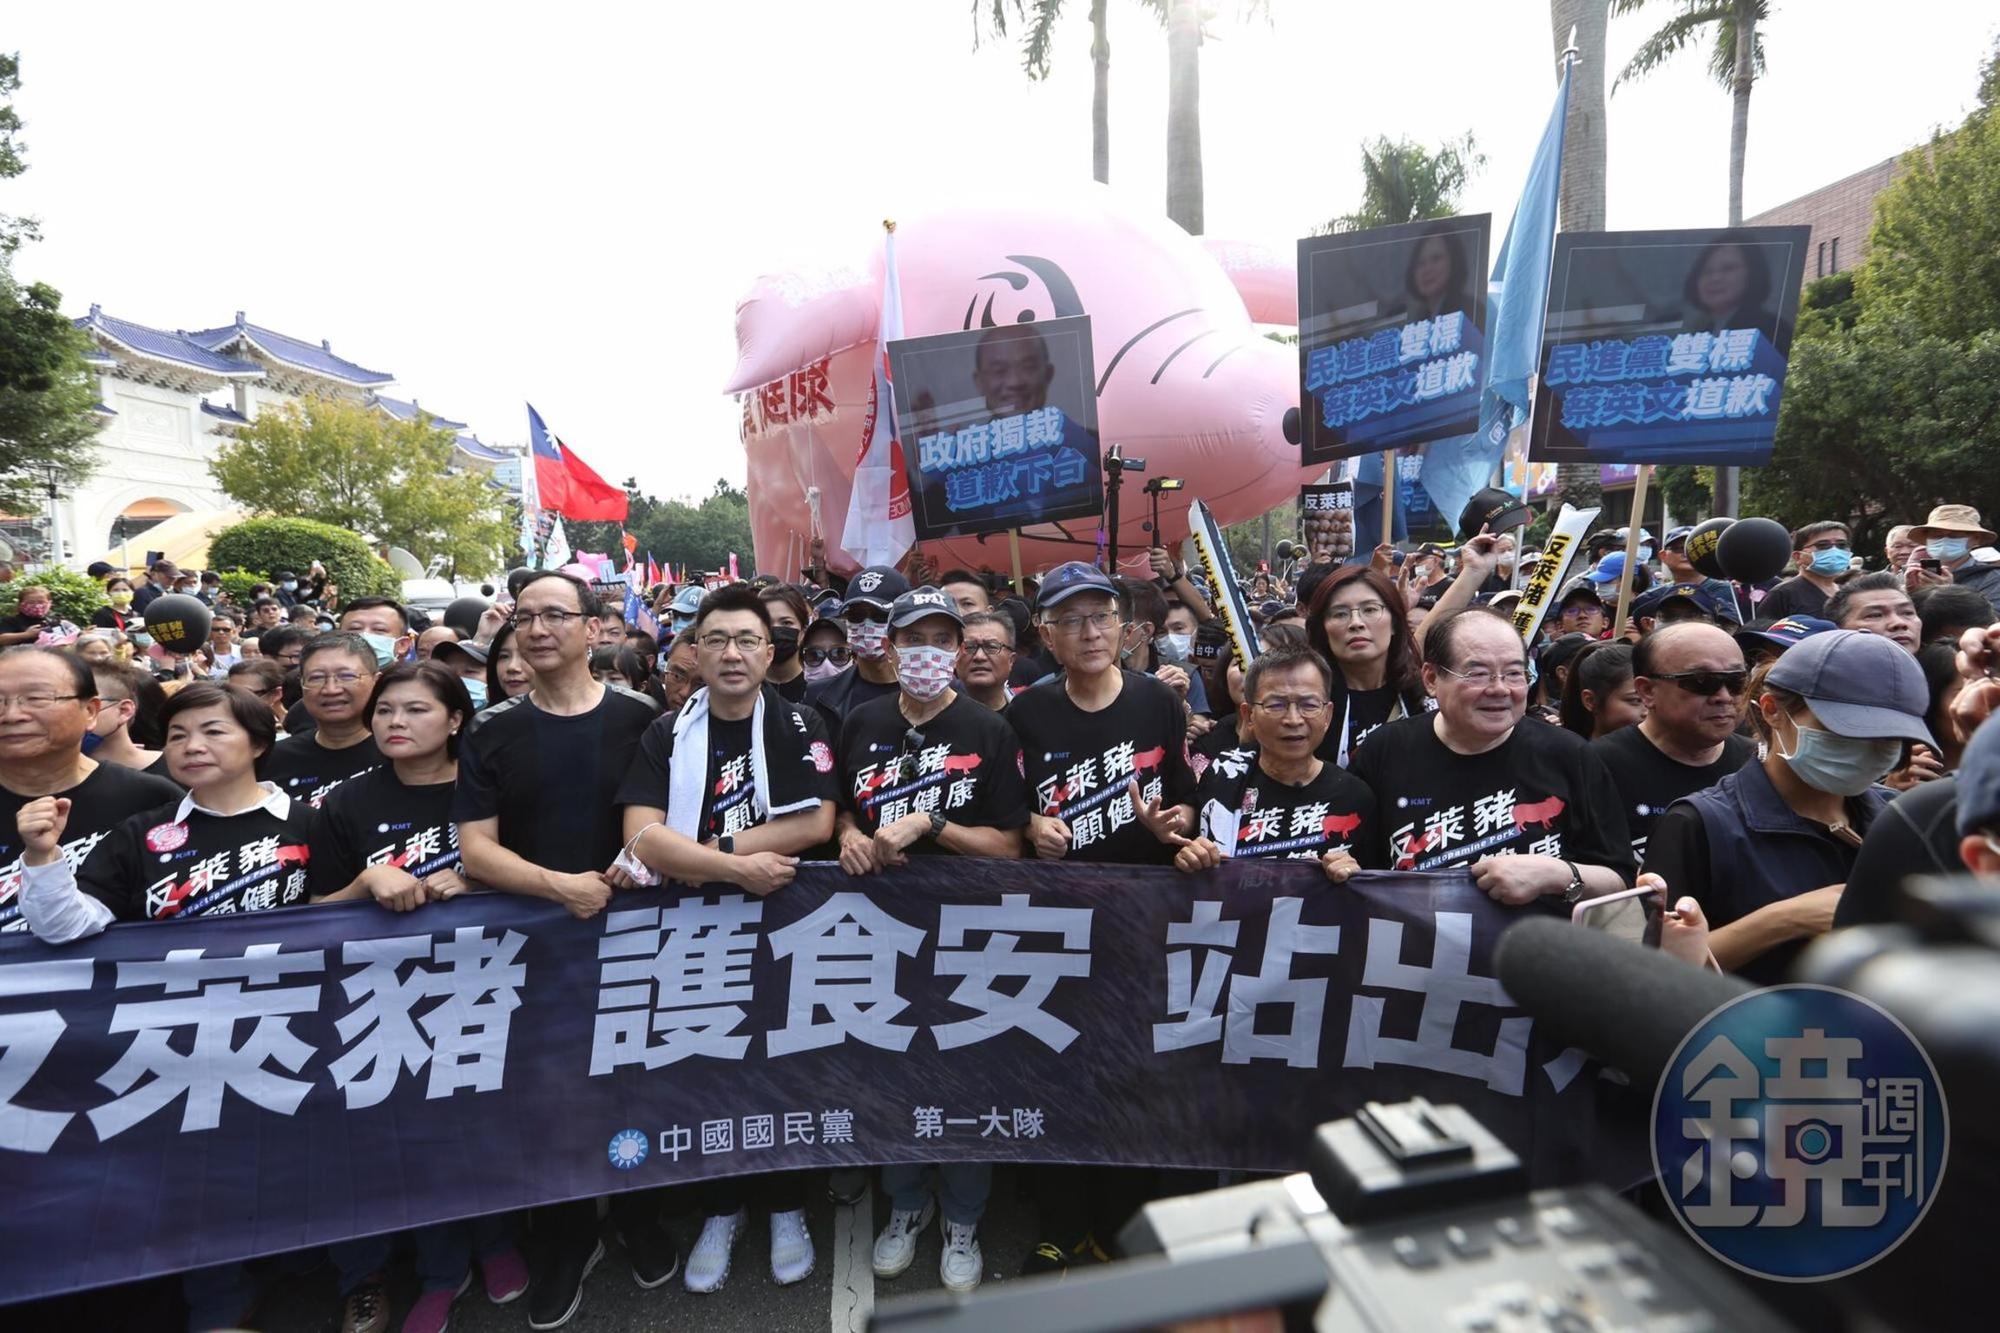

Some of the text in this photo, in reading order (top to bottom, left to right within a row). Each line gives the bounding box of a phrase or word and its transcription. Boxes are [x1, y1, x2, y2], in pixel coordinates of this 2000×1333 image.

[1305, 300, 1464, 392] 民進黨雙標
[1545, 328, 1760, 388] 民進黨雙標
[1322, 350, 1479, 428] 蔡英文道歉
[1560, 373, 1776, 429] 蔡英文道歉
[918, 406, 1064, 473] 政府獨裁
[945, 446, 1088, 513] 道歉下台
[1304, 491, 1353, 511] 反萊豬
[879, 777, 977, 829] 顧健康
[1036, 740, 1135, 816] 反萊豬
[1410, 798, 1432, 807] KMT
[1236, 840, 1297, 856] Ractopamine
[1390, 788, 1516, 871] 反萊豬
[1418, 838, 1488, 870] Ractopamine
[1489, 828, 1516, 845] Pork
[146, 834, 281, 918] 反萊豬
[588, 892, 1093, 1077] 護食安
[1153, 895, 1588, 1097] 站出
[659, 1106, 1045, 1162] 中國國民黨 第一大隊
